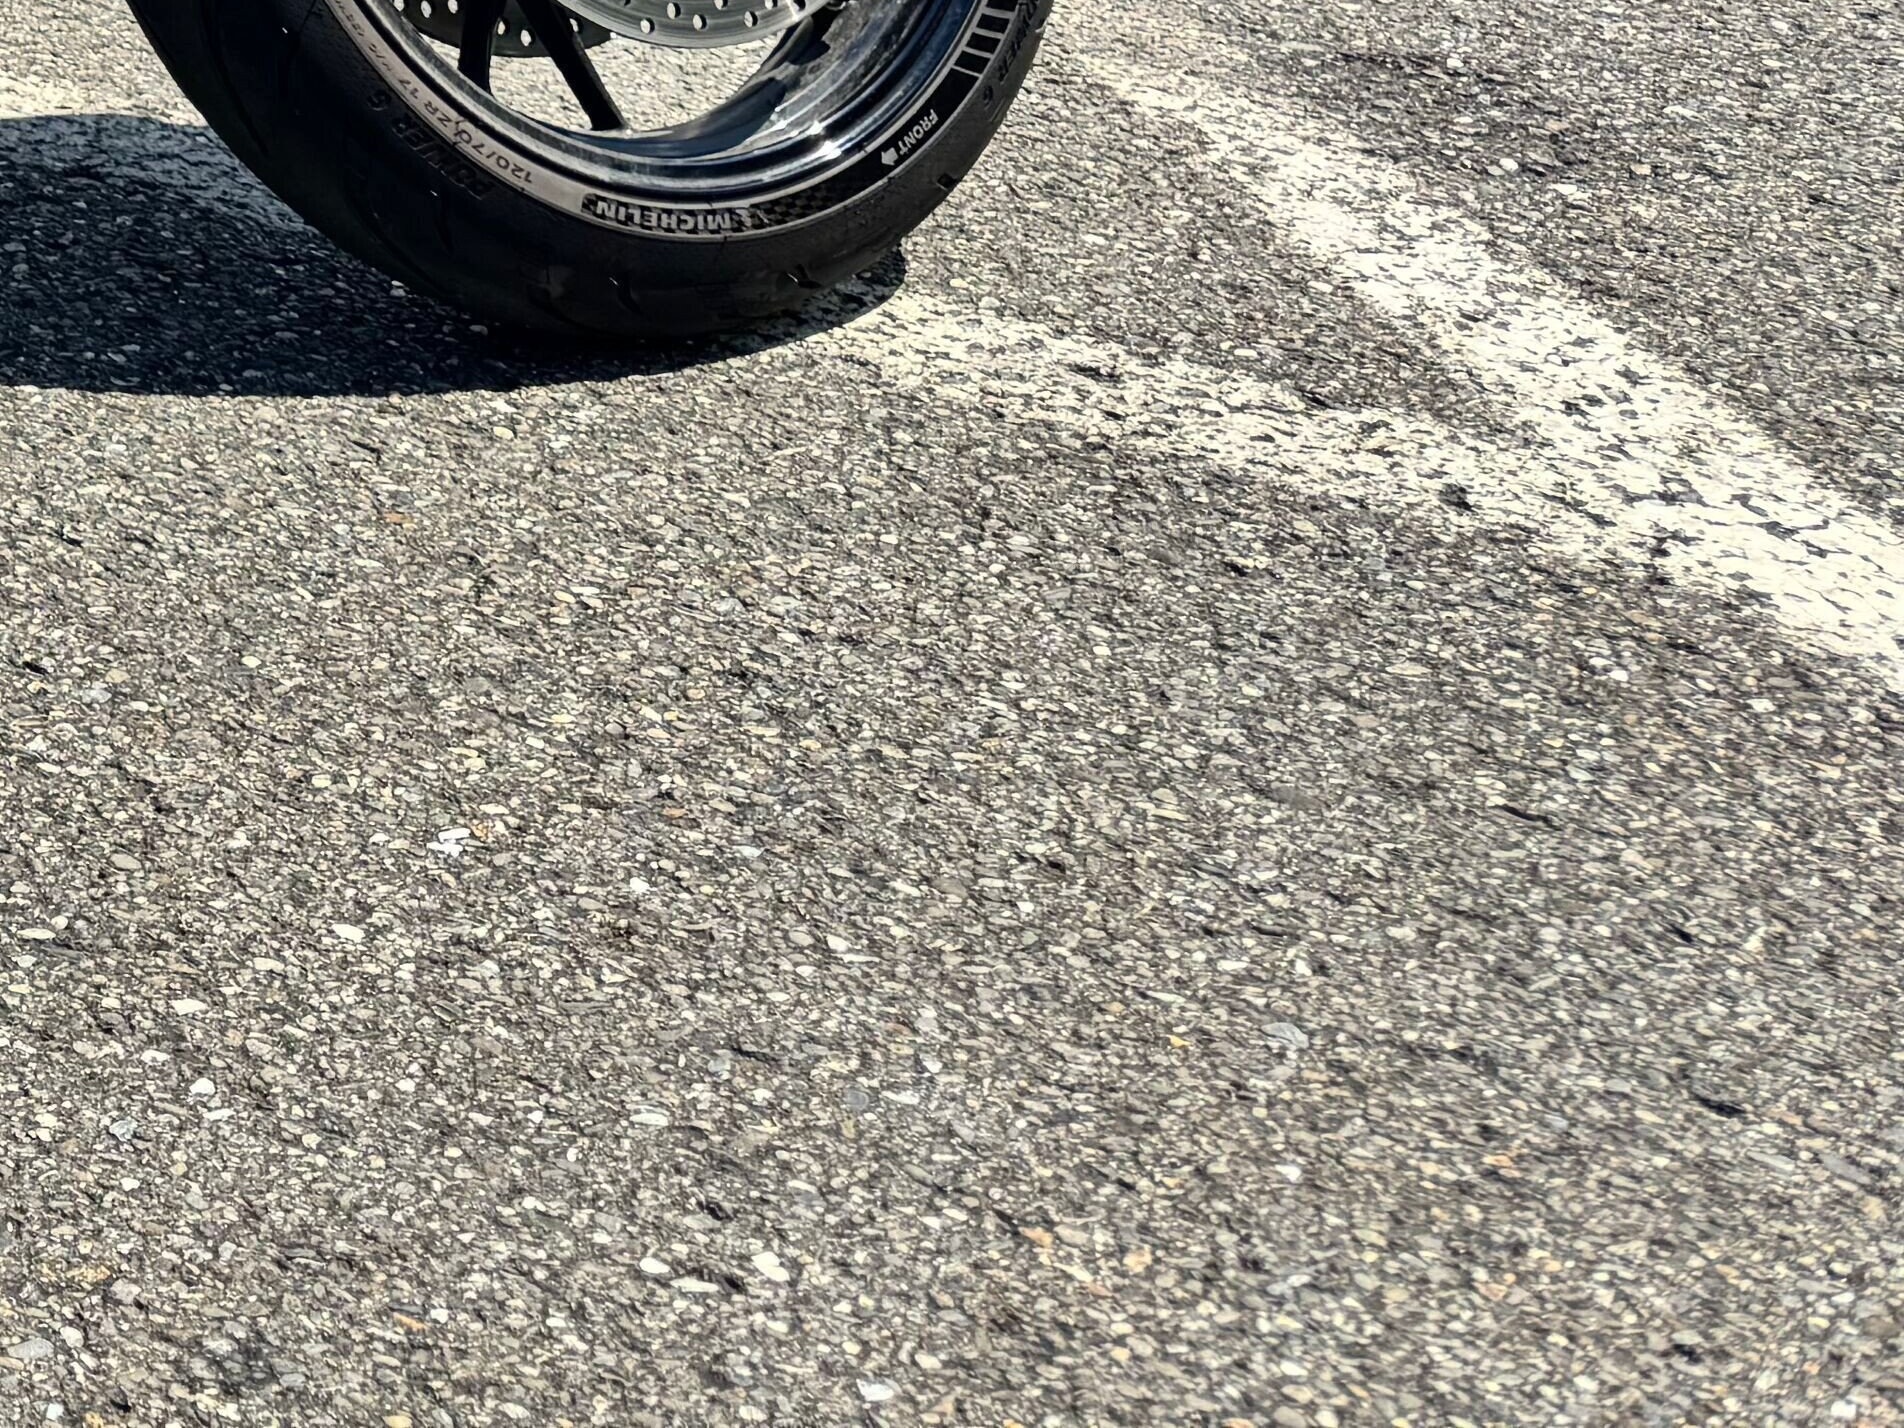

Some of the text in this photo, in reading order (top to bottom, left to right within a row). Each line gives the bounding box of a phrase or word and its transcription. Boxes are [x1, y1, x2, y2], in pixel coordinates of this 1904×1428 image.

[398, 78, 421, 101] 17
[422, 99, 452, 129] ZR
[895, 107, 940, 158] FRONT
[366, 89, 496, 202] POWER 6
[454, 129, 535, 185] 120/70
[595, 200, 733, 232] MICHELIN
